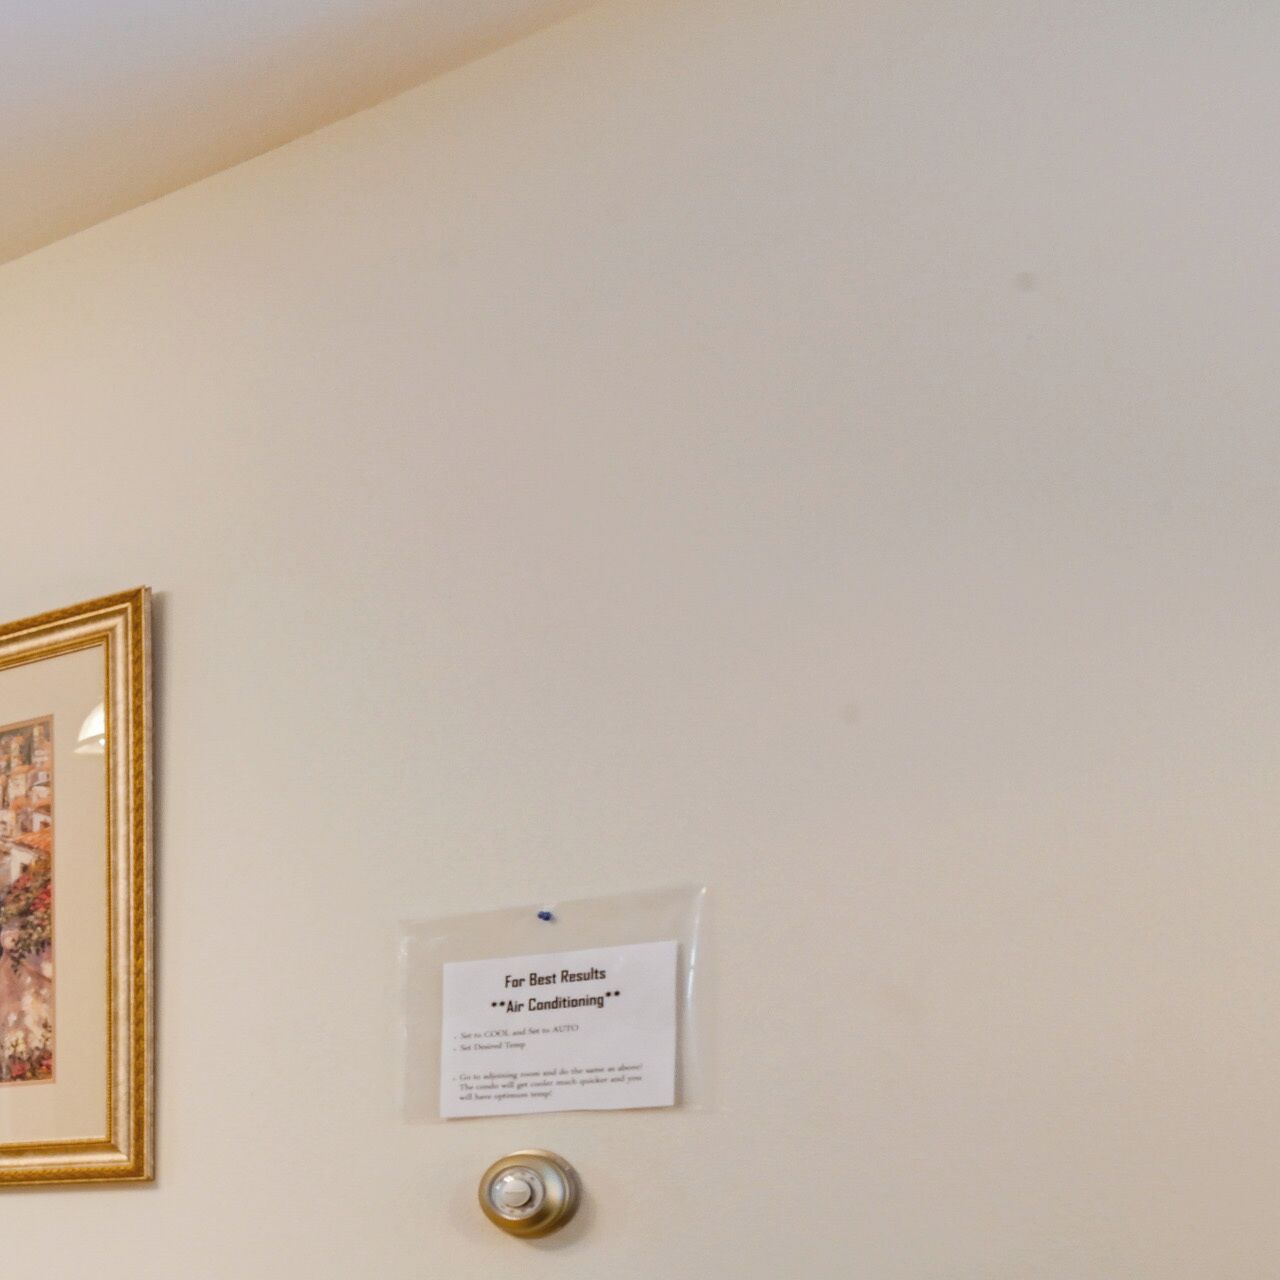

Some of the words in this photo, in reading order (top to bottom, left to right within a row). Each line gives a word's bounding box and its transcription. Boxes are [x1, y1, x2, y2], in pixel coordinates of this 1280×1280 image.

[504, 974, 526, 988] For
[529, 973, 556, 986] Best
[560, 967, 606, 983] Results
